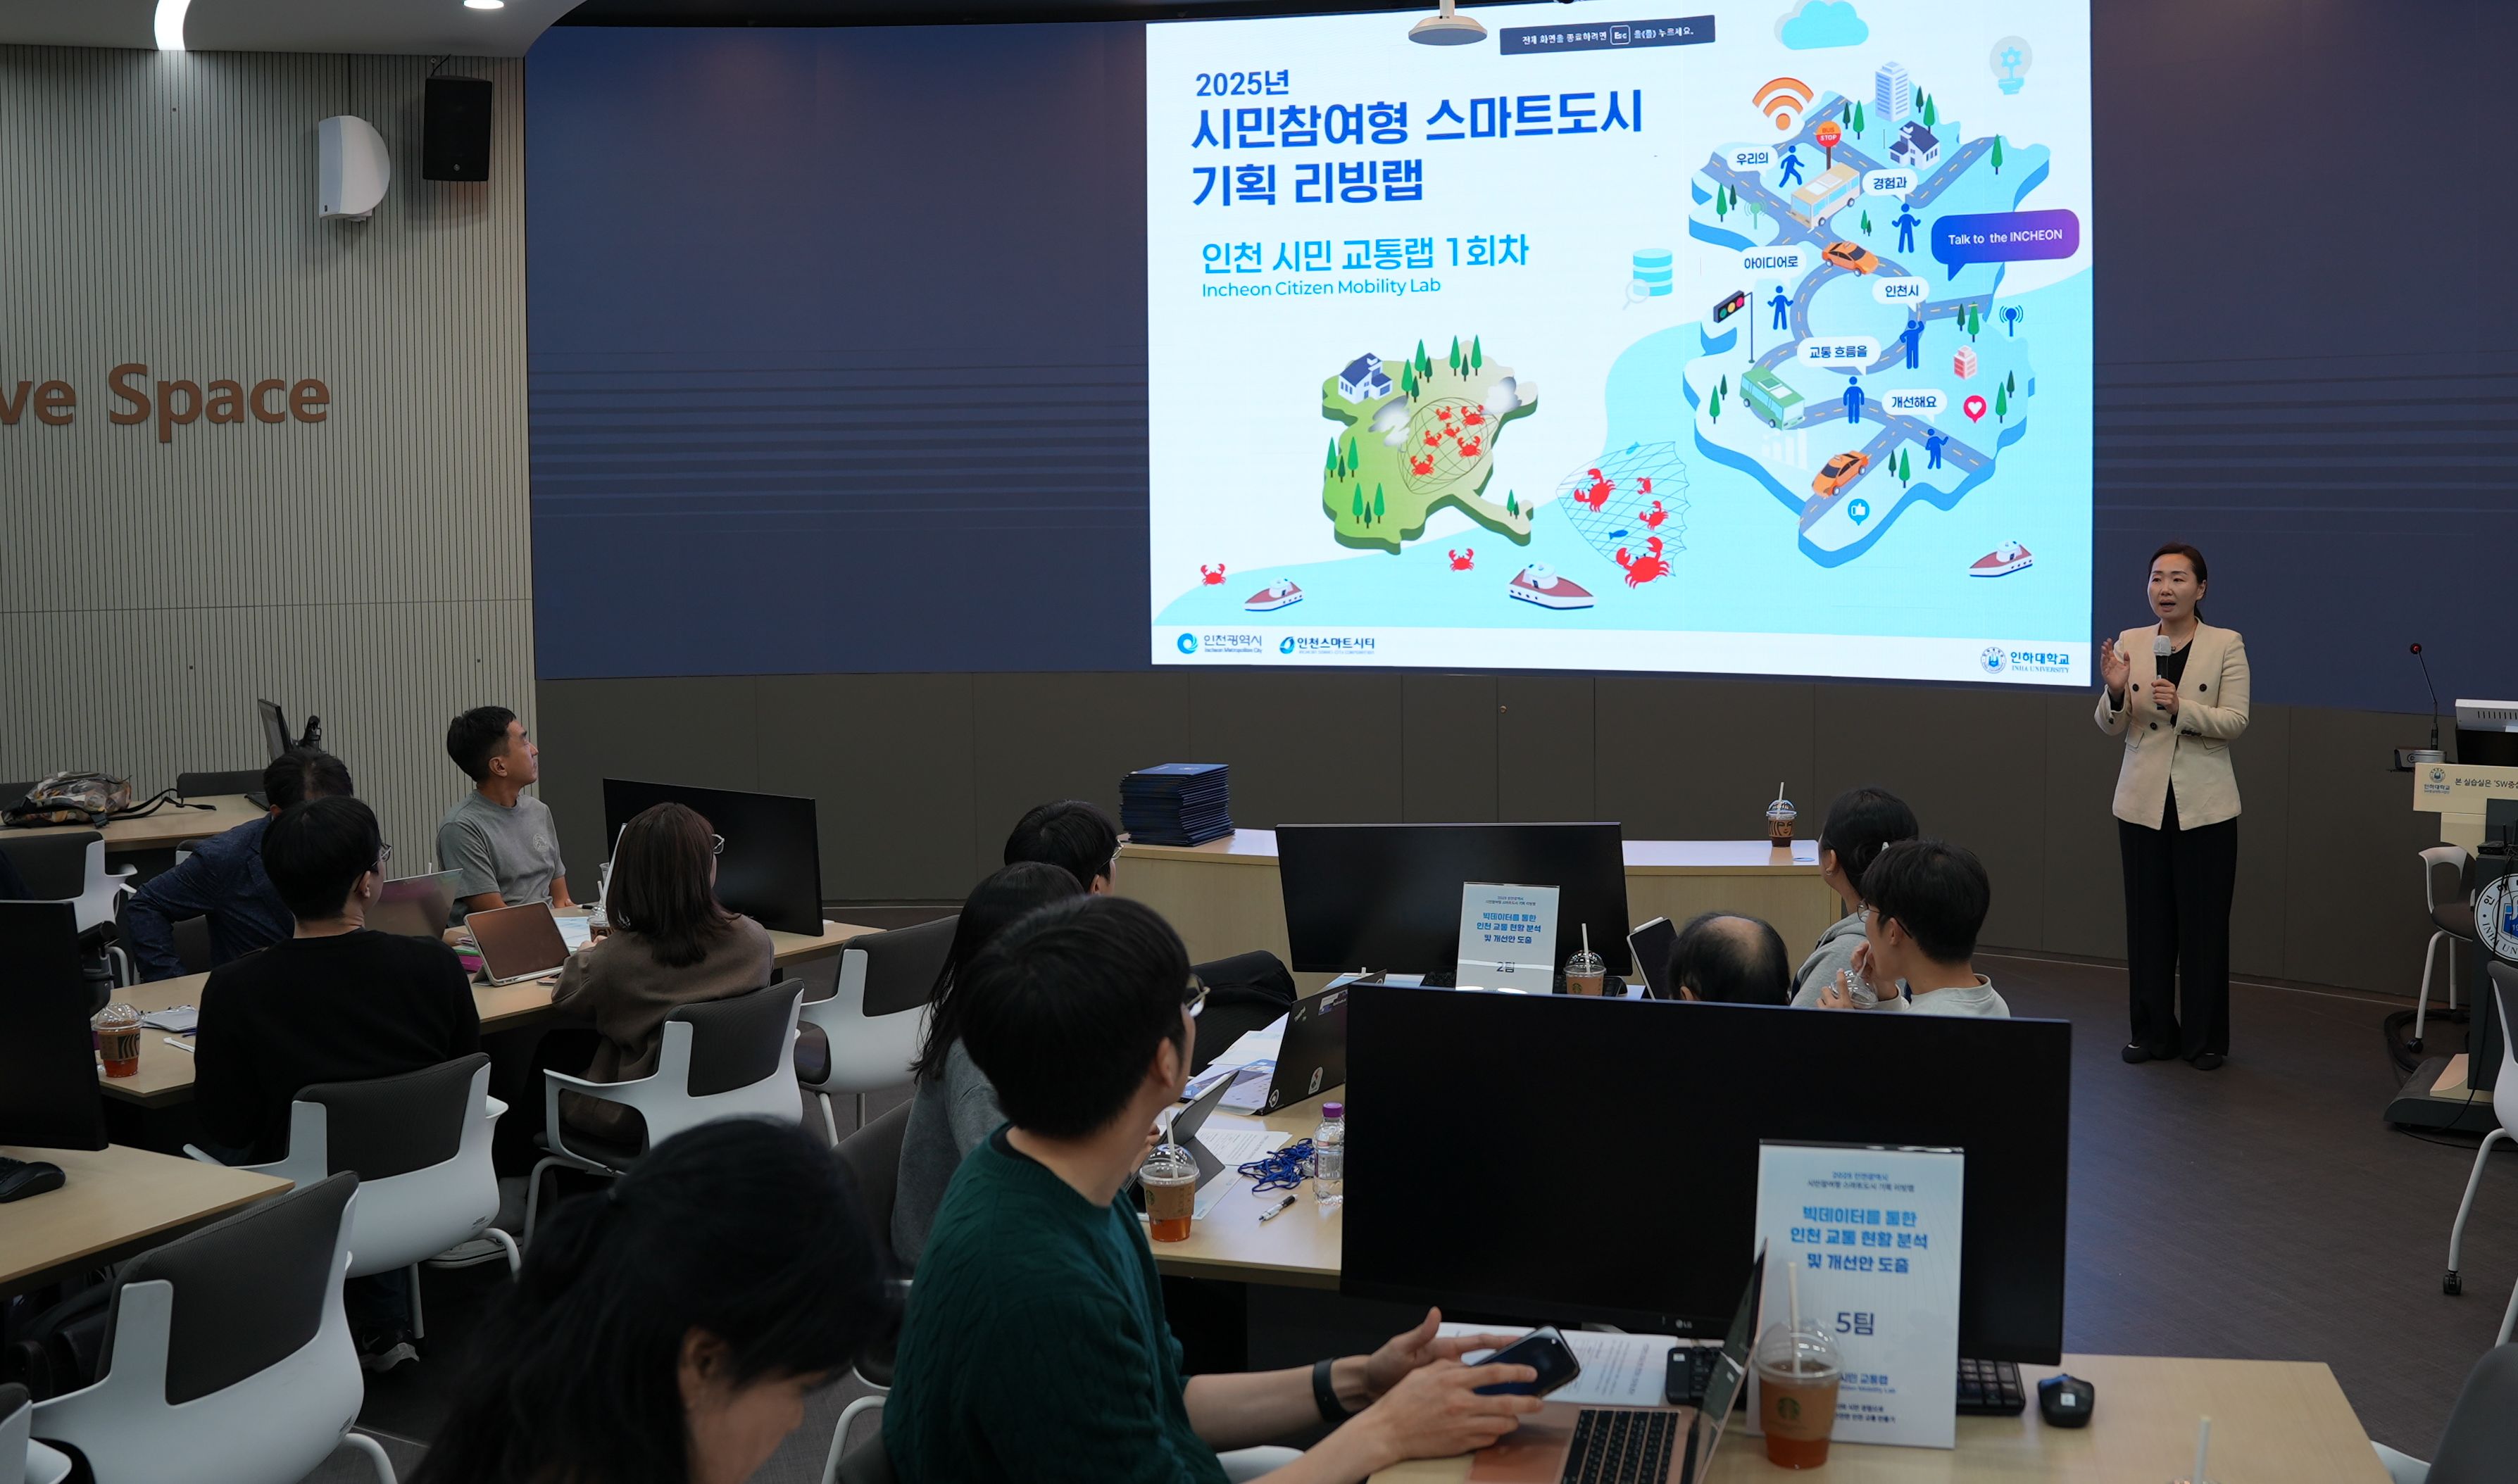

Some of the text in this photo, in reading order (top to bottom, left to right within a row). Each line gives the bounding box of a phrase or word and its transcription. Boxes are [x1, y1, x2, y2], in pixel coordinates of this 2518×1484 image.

[1659, 27, 1693, 37] 누르세요.
[1196, 70, 1289, 97] 2025년
[1191, 89, 1643, 150] 시민참여형 스마트도시
[1736, 151, 1769, 165] 우리의
[1192, 159, 1424, 206] 기획 리빙랩
[1872, 176, 1907, 190] 경험과
[1948, 229, 2062, 245] Talk to the INCHEON
[1202, 234, 1529, 275] 인천 시민 교통랩 1회차
[1743, 256, 1798, 270] 아이디어로
[1202, 278, 1441, 298] Incheon Citizen Mobility Lab
[1886, 284, 1919, 298] 인천시
[1810, 345, 1867, 359] 교통 흐름을
[0, 363, 330, 443] ve Space
[1891, 395, 1937, 409] 개선해요
[1204, 635, 1262, 646] 인천광역시
[1297, 637, 1374, 649] 인천스마트시티
[2010, 652, 2069, 665] 인하대학교
[2455, 777, 2462, 786] 본
[2464, 779, 2492, 788] 실습실은
[1526, 924, 1541, 933] 분석
[1493, 935, 1515, 943] 개선안
[1496, 962, 1515, 973] 2팀
[1803, 1206, 1917, 1227] 빅데이터를 통한
[1791, 1227, 1928, 1250] 인천 교통 현황 분석
[1808, 1253, 1909, 1274] 및 개선안 도출
[1836, 1312, 1874, 1335] 5팀
